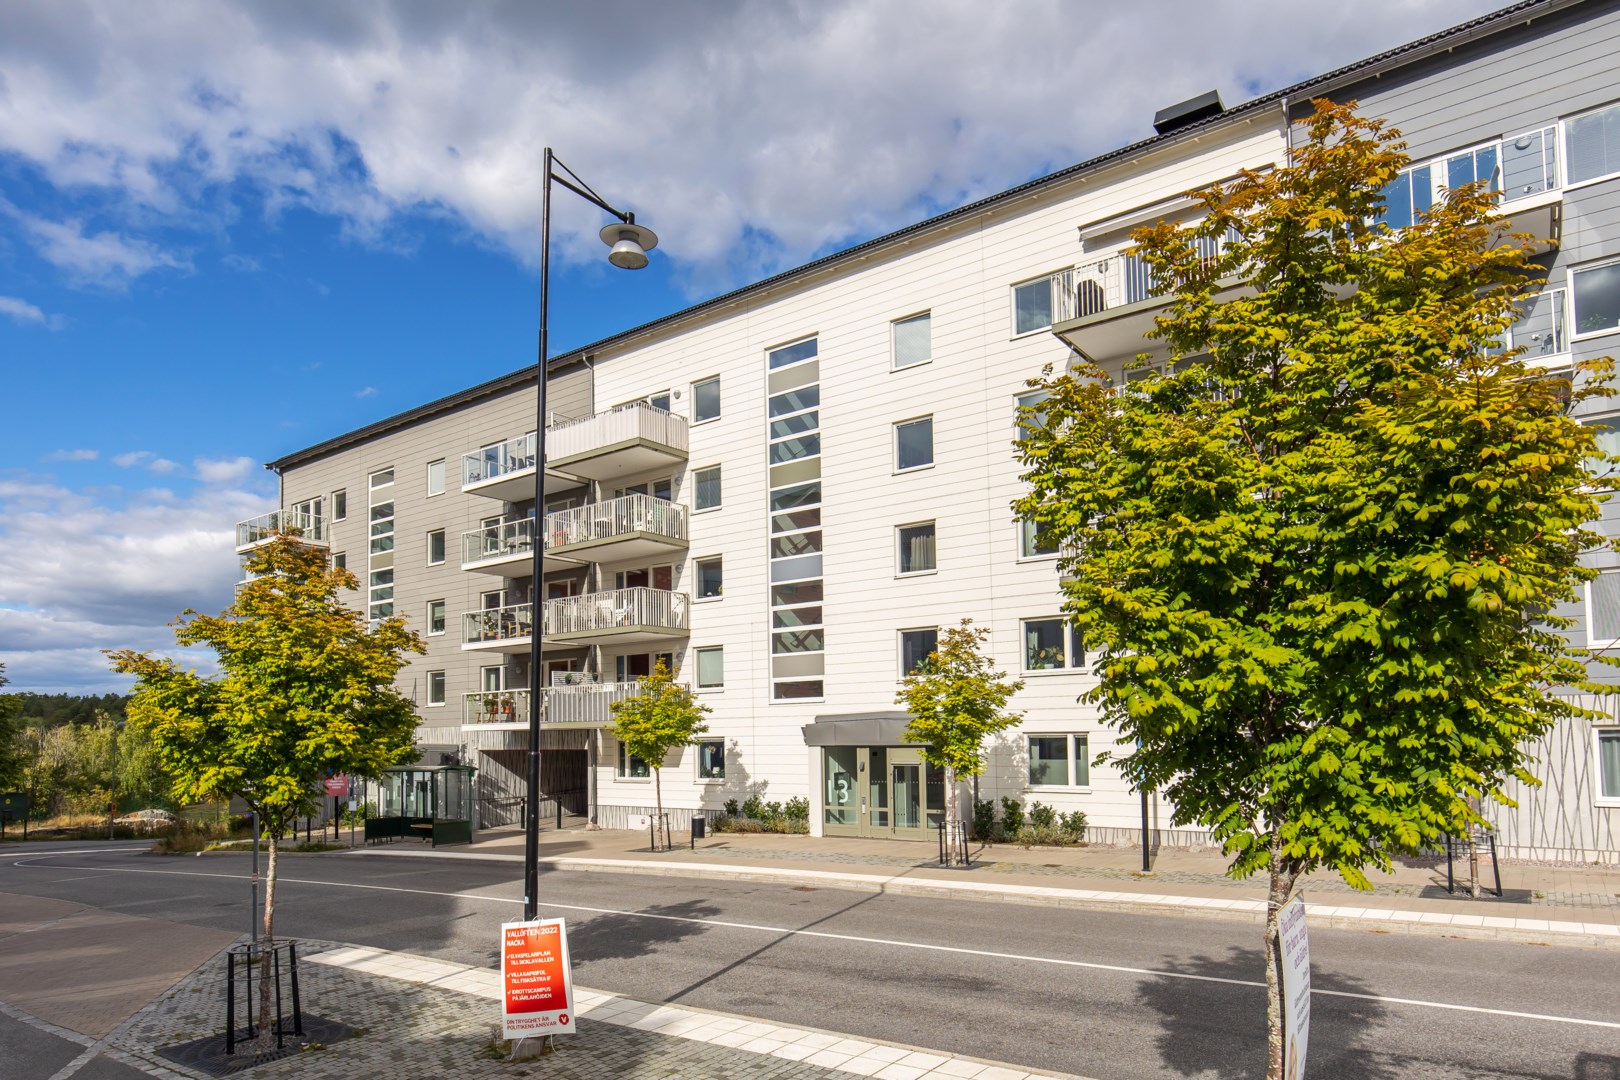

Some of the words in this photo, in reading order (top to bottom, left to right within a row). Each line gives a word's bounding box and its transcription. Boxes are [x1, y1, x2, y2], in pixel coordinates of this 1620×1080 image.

[828, 779, 849, 803] 13
[507, 928, 539, 937] VALLÖFTEN
[506, 939, 525, 947] NACKA
[519, 957, 554, 965] SICKLAVALLEN
[512, 987, 551, 995] IDROTTSCAMPUS
[515, 1017, 541, 1025] TRYGGHET
